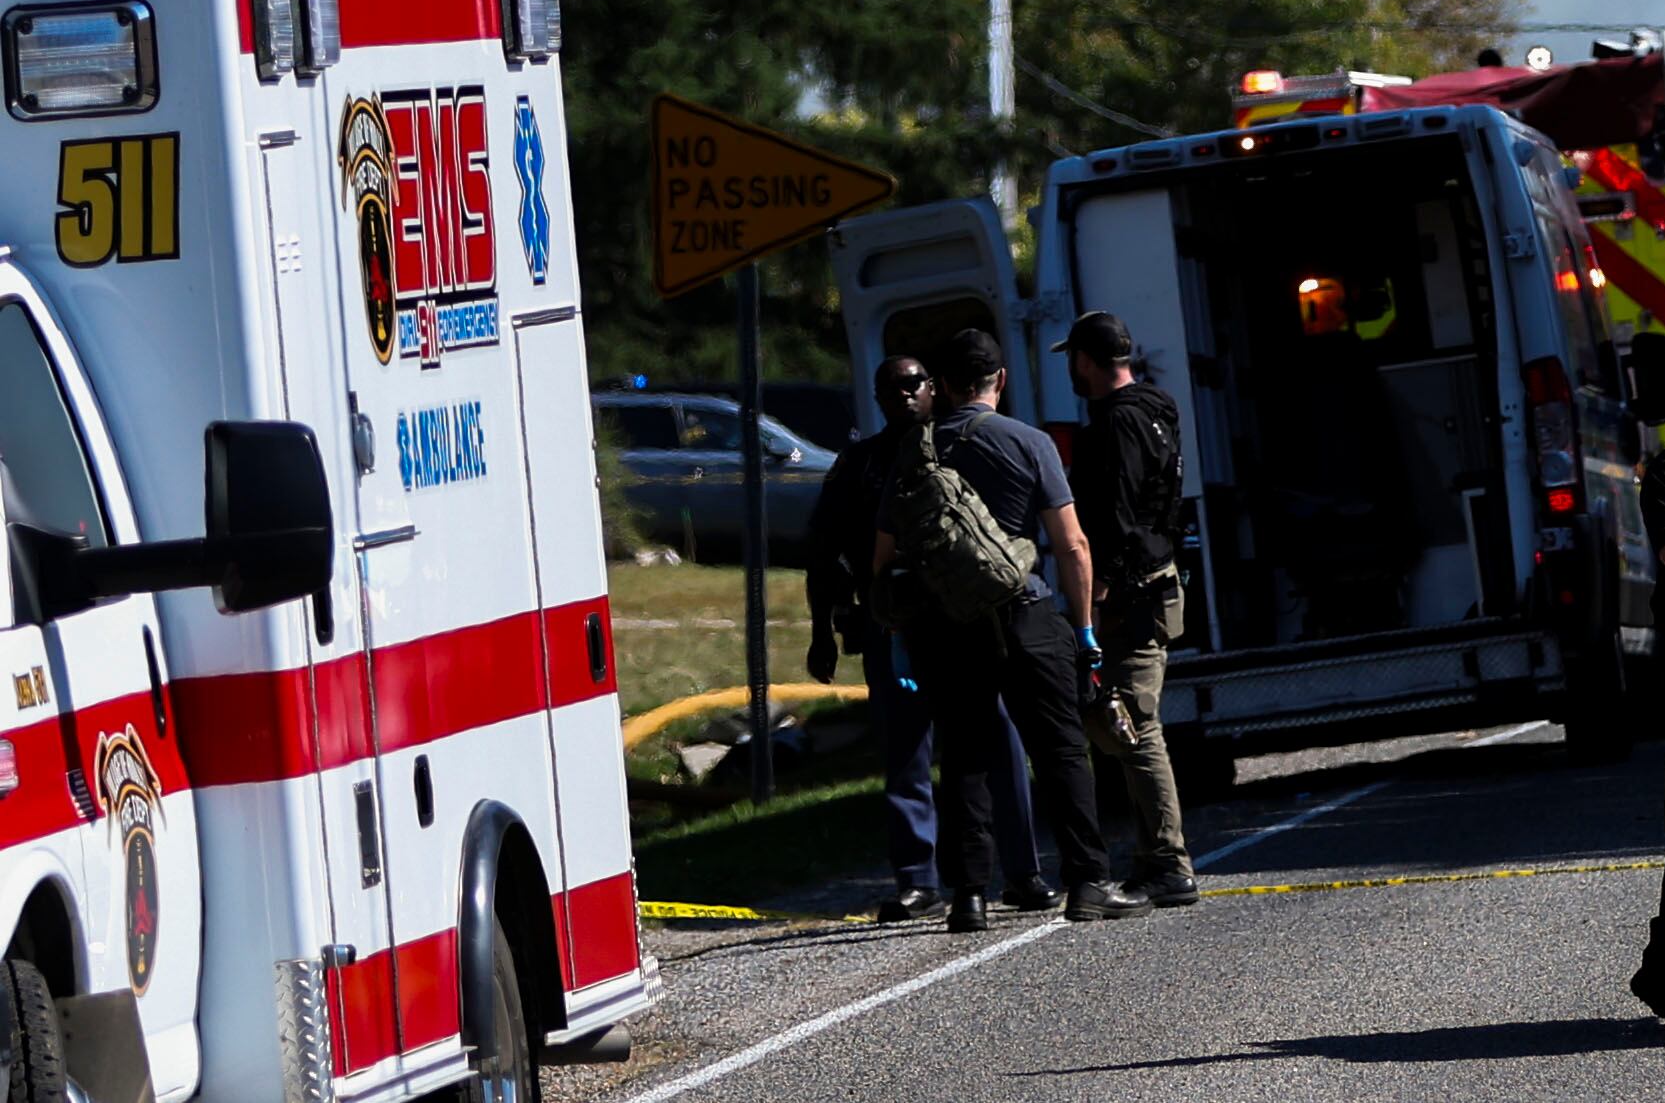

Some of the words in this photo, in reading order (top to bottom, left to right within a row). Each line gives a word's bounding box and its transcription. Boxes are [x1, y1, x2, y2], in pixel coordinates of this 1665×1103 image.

[667, 136, 717, 168] NO
[54, 131, 180, 269] 511
[380, 85, 497, 300] EMS
[668, 174, 832, 210] PASSING
[671, 219, 745, 254] ZONE
[417, 299, 441, 370] 911
[412, 399, 487, 489] AMBULANCE
